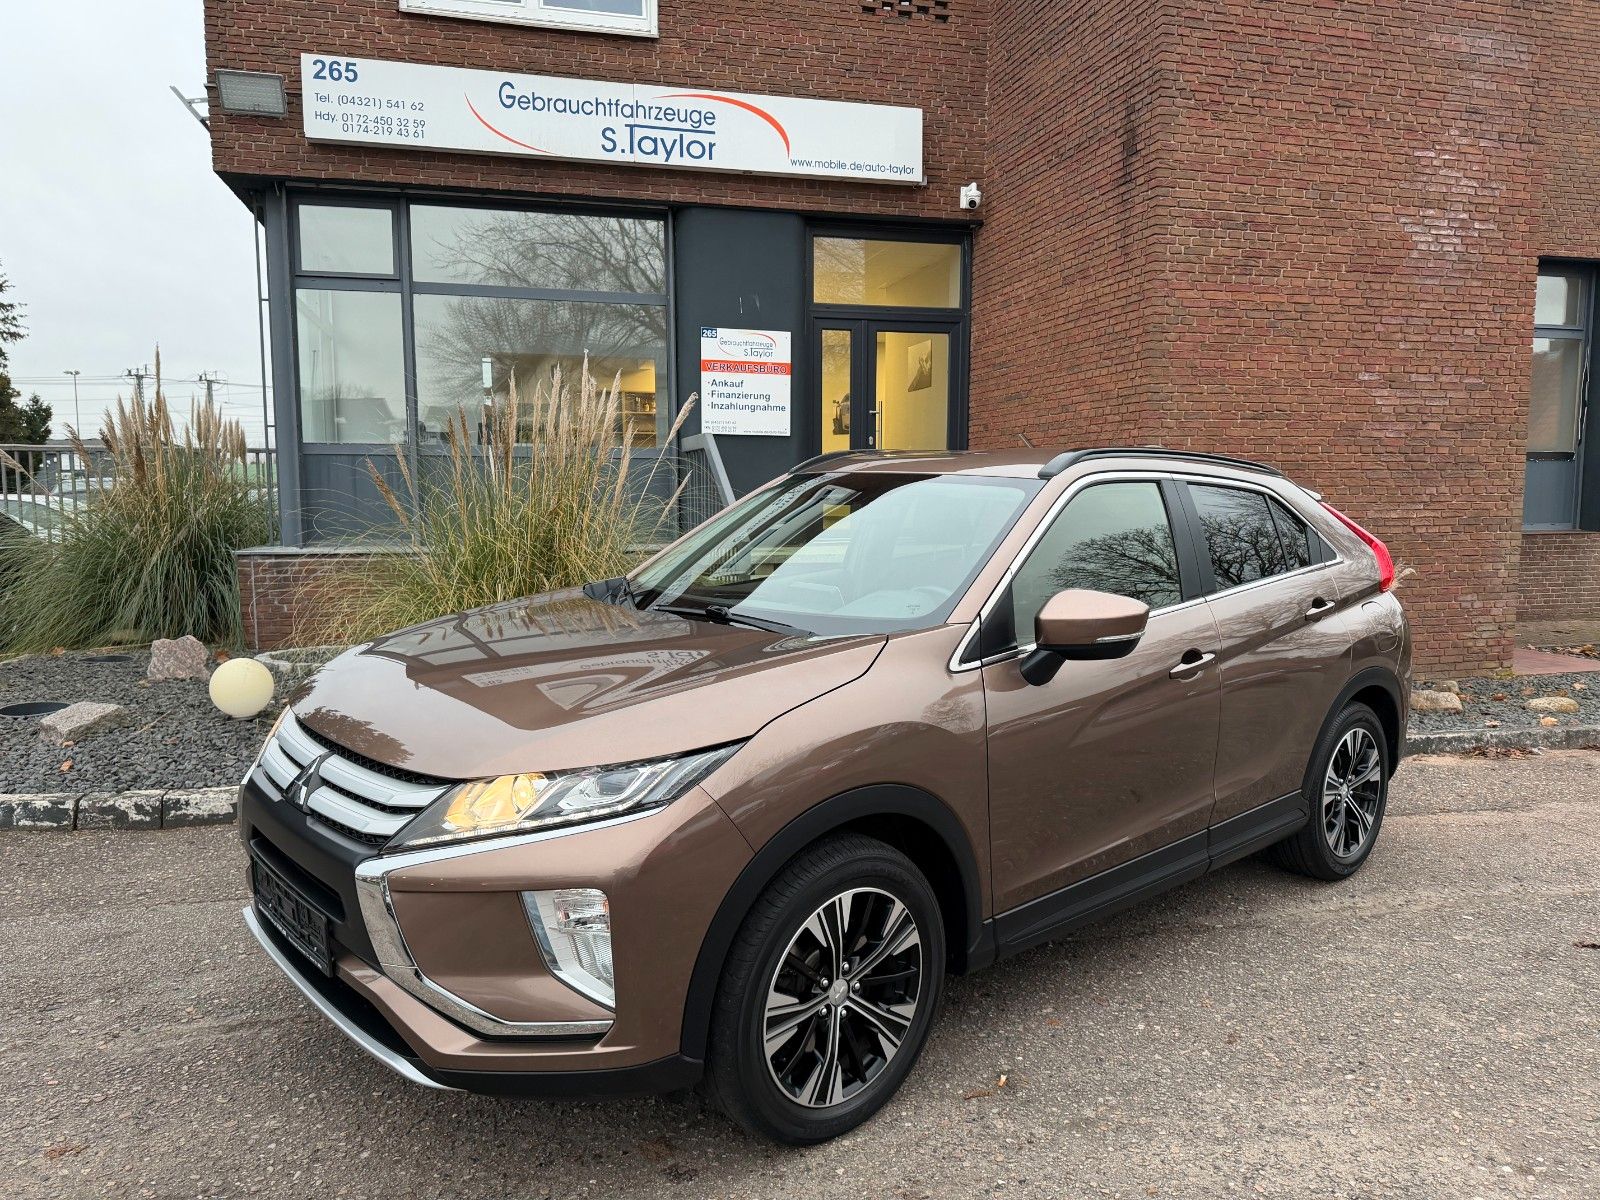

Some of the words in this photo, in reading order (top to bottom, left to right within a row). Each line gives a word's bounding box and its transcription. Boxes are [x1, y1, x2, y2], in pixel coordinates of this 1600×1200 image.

[312, 59, 359, 83] 265
[314, 92, 334, 104] Tel.
[337, 94, 382, 109] (04321)
[386, 99, 406, 110] 541
[410, 101, 425, 112] 62
[499, 81, 716, 129] Gebrauchtfahrzeuge
[314, 110, 338, 123] Hdy.
[341, 112, 393, 127] 0172-450
[396, 117, 410, 128] 32
[412, 119, 426, 129] 59
[342, 122, 393, 136] 0174-219
[396, 127, 410, 138] 43
[413, 129, 425, 139] 61
[601, 124, 716, 163] S.Taylor
[790, 157, 915, 176] www.mobile.de/auto-taylor
[702, 329, 717, 338] 265
[744, 347, 774, 358] S.Taylor
[711, 379, 744, 388] Ankauf
[711, 390, 771, 402] Finanzierung
[711, 402, 786, 413] Inzahlungnahme
